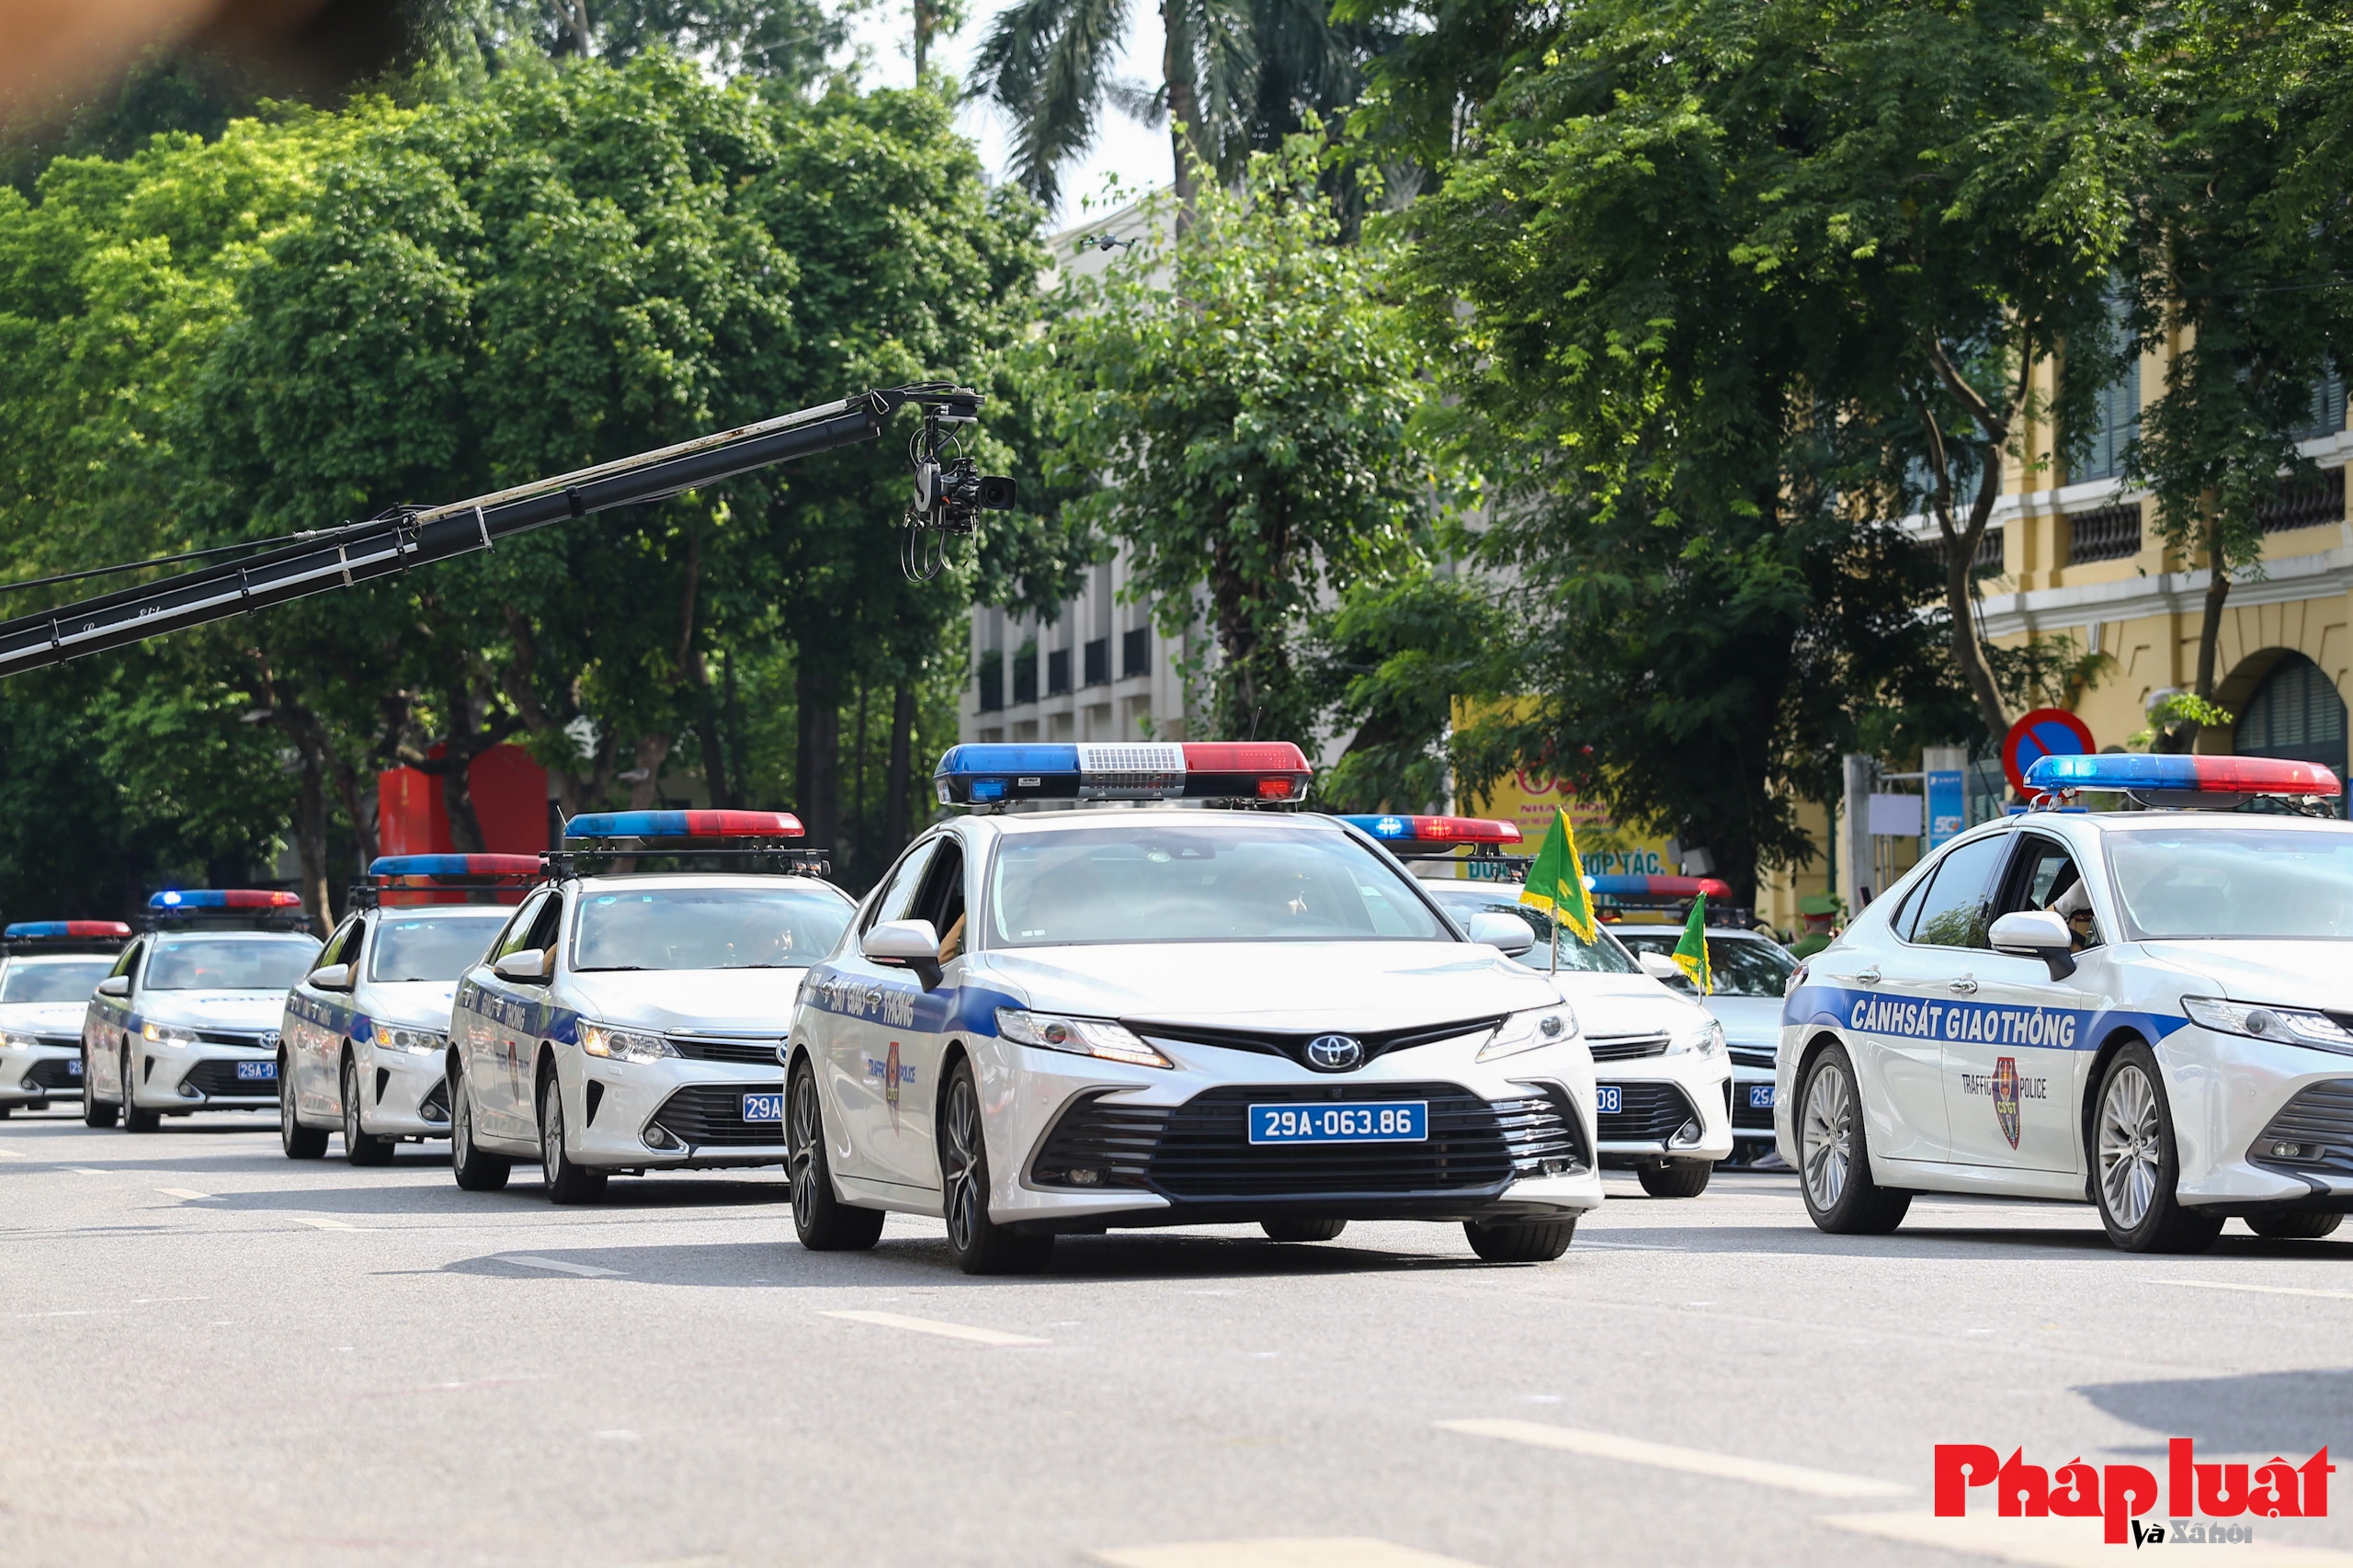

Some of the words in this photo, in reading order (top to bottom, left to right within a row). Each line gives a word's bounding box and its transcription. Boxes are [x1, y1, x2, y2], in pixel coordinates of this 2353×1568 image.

[1961, 1074, 1992, 1096] TRAFFIC
[2019, 1077, 2047, 1099] POLICE
[747, 1097, 781, 1119] 29A
[1597, 1089, 1618, 1109] 08
[1265, 1109, 1412, 1136] 29A-063.86
